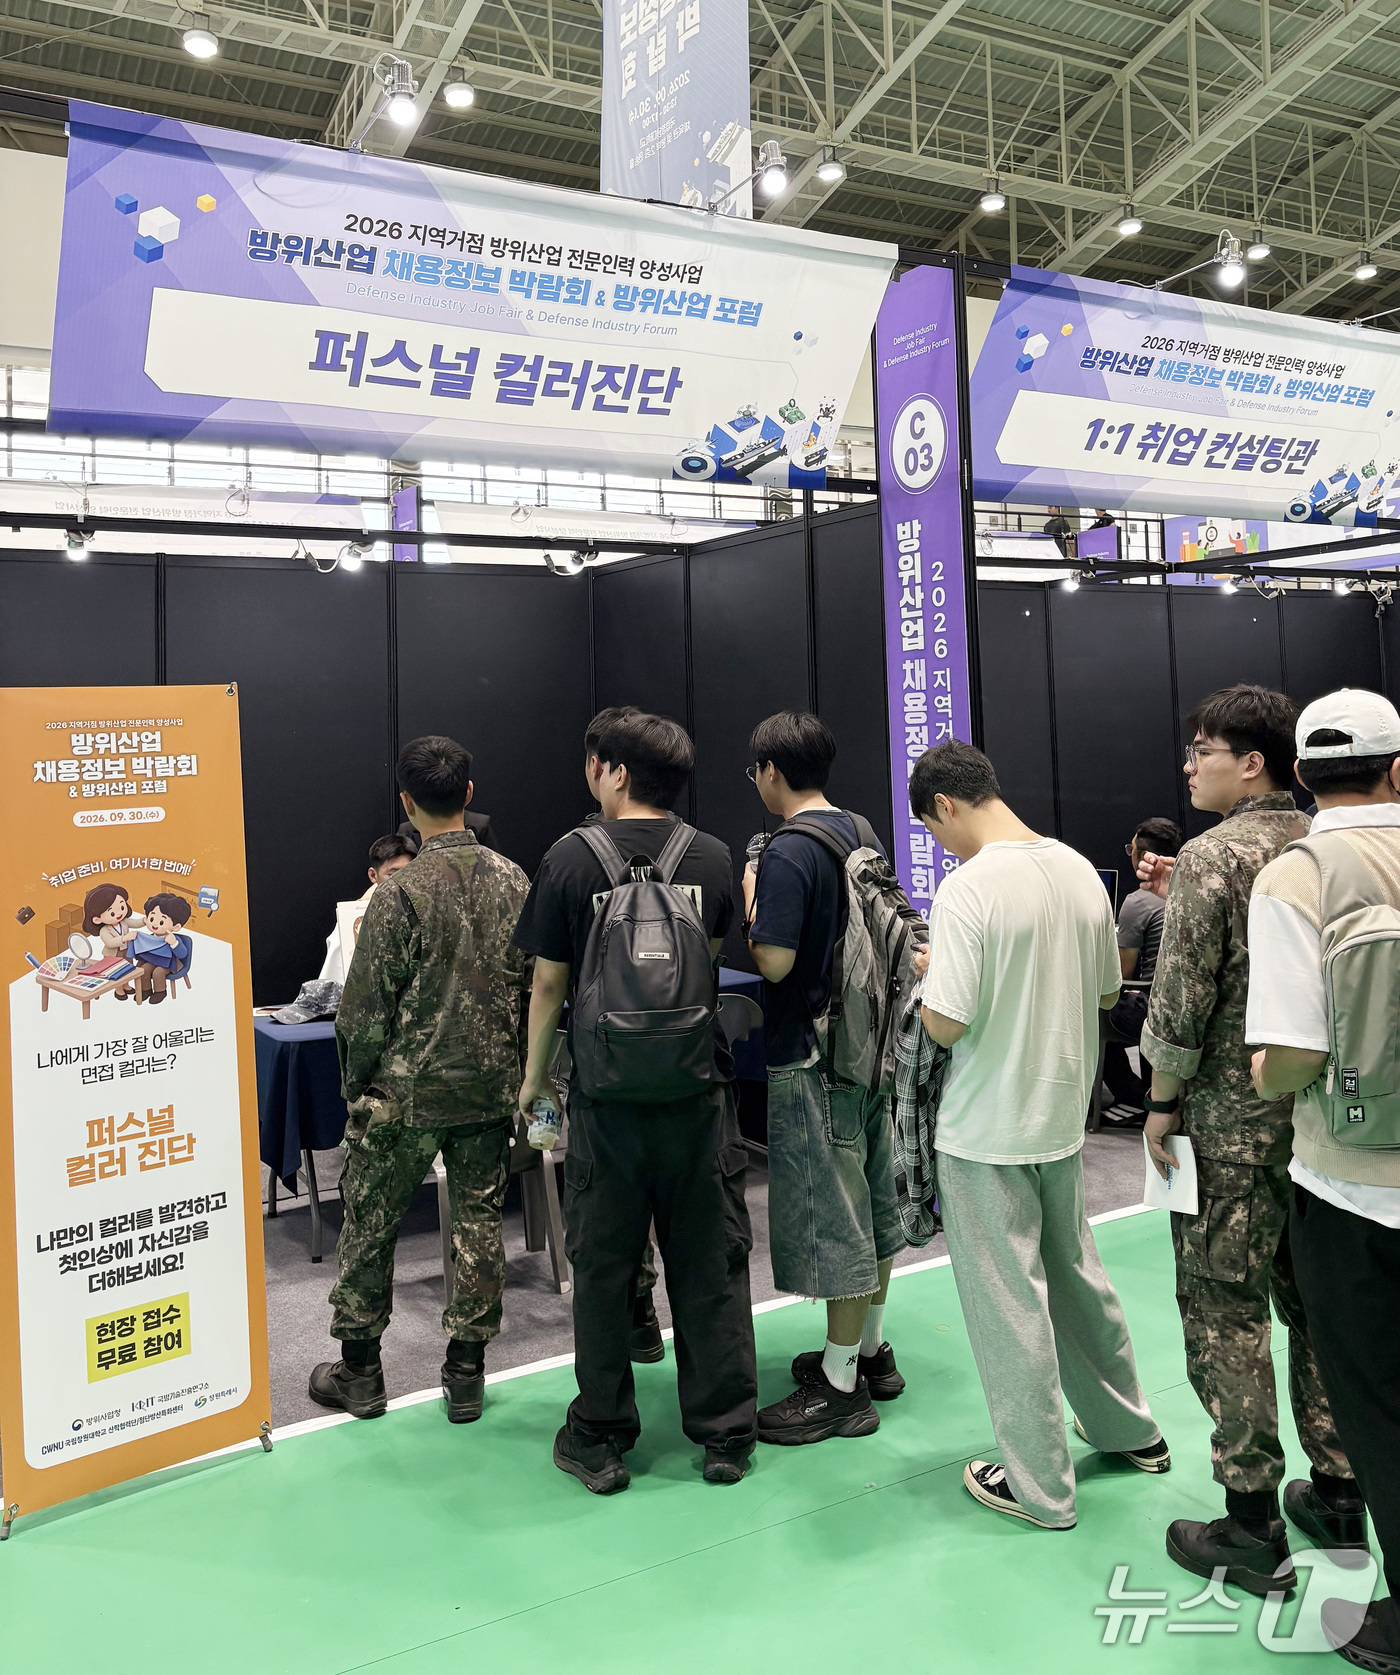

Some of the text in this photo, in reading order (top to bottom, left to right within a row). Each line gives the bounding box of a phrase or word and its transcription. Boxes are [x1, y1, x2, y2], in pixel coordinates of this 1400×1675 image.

[343, 213, 704, 285] 2026 지역거점 방위산업 전문인력 양성사업
[247, 229, 764, 328] 방위산업 채용정보 박람회 & 방위산업 포럼
[346, 282, 678, 336] Defense Industry Job Fair & Defense Industry Forum
[883, 337, 950, 369] & Defense Industry Forum
[893, 322, 938, 346] Defense Industry
[904, 336, 926, 351] Job Fair
[308, 329, 683, 416] 퍼스널 컬러진단
[1079, 346, 1376, 408] 방위산업 채용정보 박람회 & 방위산업 포럼
[1141, 335, 1346, 379] 2026 지역거점 방위산업 전문인력 양성사업
[909, 411, 926, 440] C
[1237, 399, 1267, 411] Defense
[1267, 402, 1297, 415] Industry
[1296, 407, 1319, 417] Forum
[904, 442, 934, 476] 03
[1084, 418, 1321, 476] 1:1 취업 컨설팅관
[895, 518, 926, 652] 방위산업
[931, 560, 954, 742] 2026 지역거
[45, 718, 183, 730] 2026 지역거점 방위산업 전문인력 양성사업
[902, 658, 930, 777] 채용정
[70, 730, 162, 756] 방위산업
[32, 754, 198, 783] 채용정보 박람회
[68, 779, 167, 798] & 방위산업 포럼
[79, 810, 160, 824] 2026. 09. 30.(수)
[48, 857, 193, 888] 취업 준비, 여기서 한 번에!
[37, 1026, 215, 1069] 나에게 가장 잘 어울리는
[81, 1053, 177, 1085] 면접 컬러는?
[86, 1104, 175, 1148] 퍼스널
[66, 1132, 197, 1188] 컬러 진단
[36, 1191, 228, 1254] 나만의 컬러를 발견하고
[58, 1220, 210, 1275] 첫인상에 자신감을
[88, 1251, 185, 1294] 더해보세요!
[95, 1304, 182, 1344] 현장 접수
[96, 1328, 183, 1371] 무료 참여
[86, 1408, 121, 1427] 방위사업청
[41, 1440, 64, 1456] CWNU
[64, 1428, 107, 1447] 국립창원대학교
